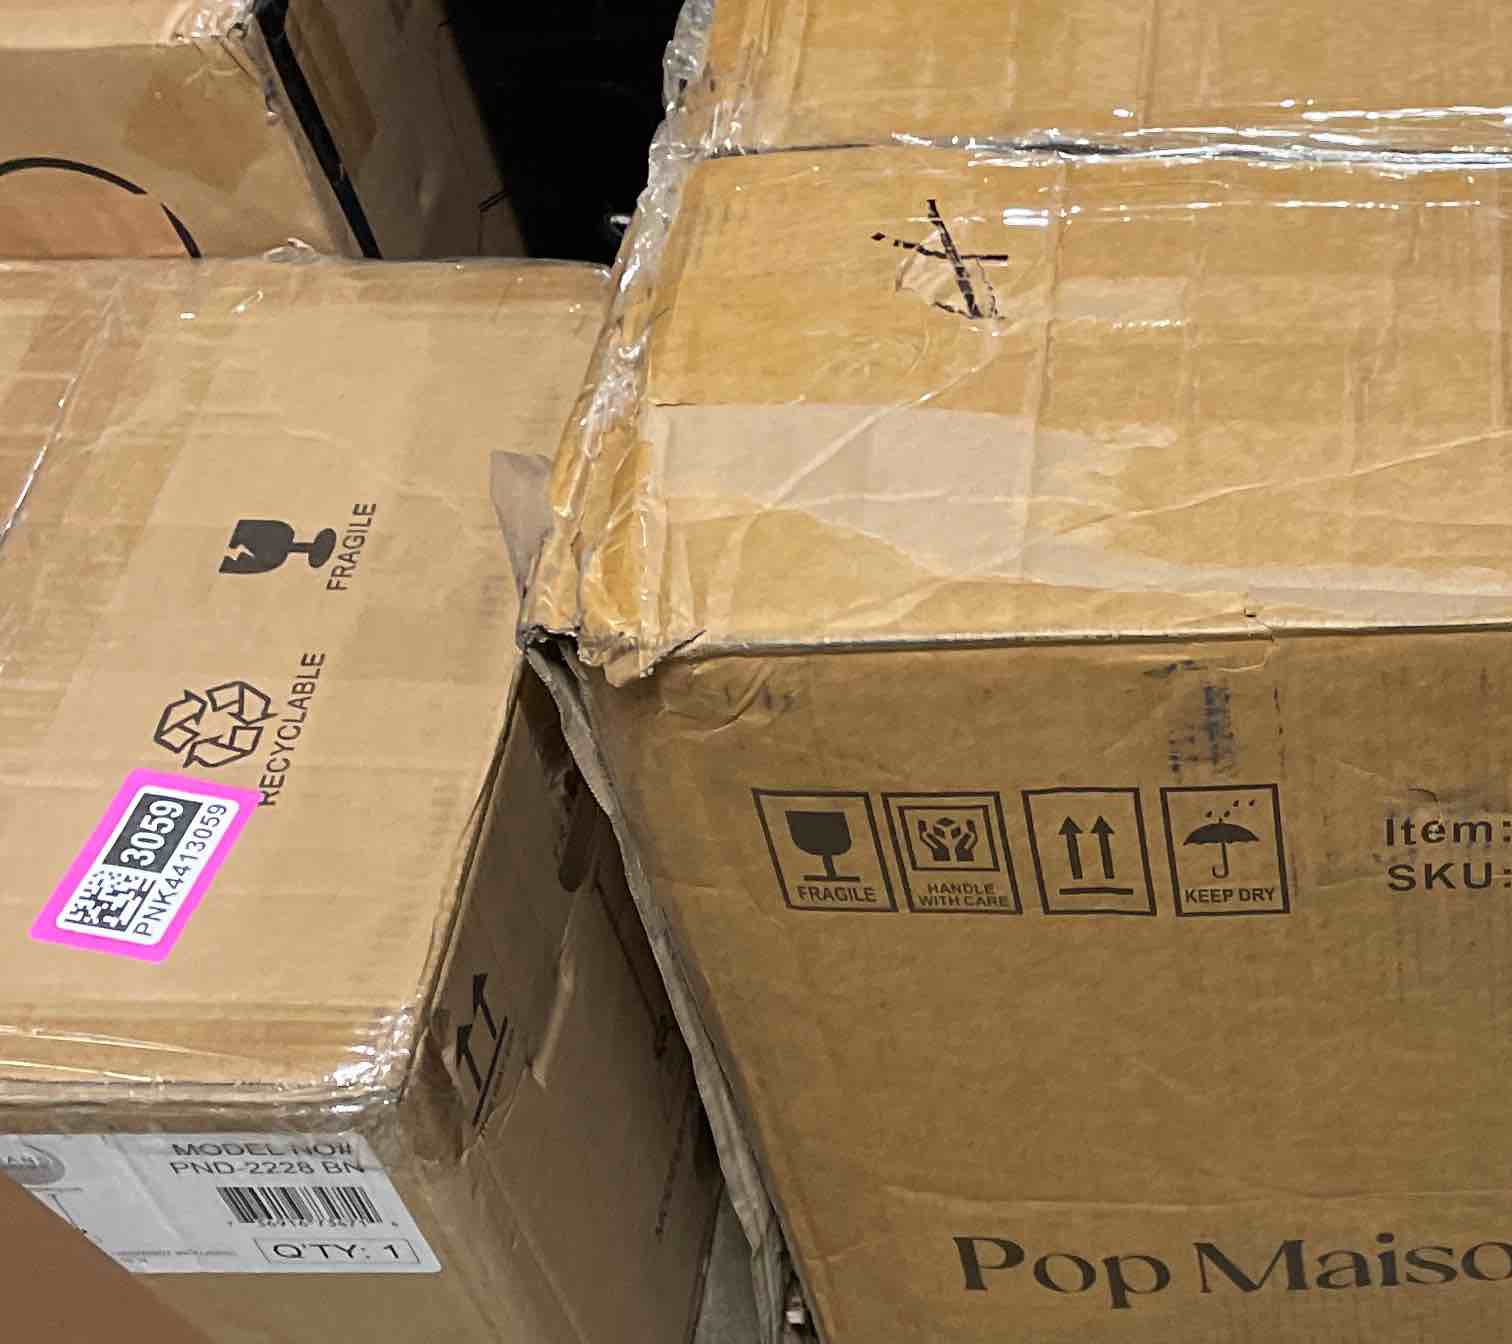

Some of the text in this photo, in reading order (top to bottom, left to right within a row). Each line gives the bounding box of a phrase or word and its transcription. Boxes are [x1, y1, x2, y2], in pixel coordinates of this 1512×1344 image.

[326, 504, 377, 591] FRAGILE
[258, 653, 325, 806] RECYCLABLE
[120, 800, 184, 867] 3059
[1385, 815, 1512, 846] Item:
[133, 804, 228, 936] PNK4413059
[1386, 860, 1512, 891] SKU:
[798, 884, 876, 905] FRAGILE
[918, 895, 1009, 908] WITH CARE
[927, 882, 996, 895] HANDLE
[1185, 886, 1276, 904] KEEP DRY
[172, 1143, 285, 1156] MODEL
[169, 1161, 365, 1174] PND-2228 BN
[273, 1244, 400, 1259] Q'TY: 1
[952, 1234, 1171, 1309] Pop
